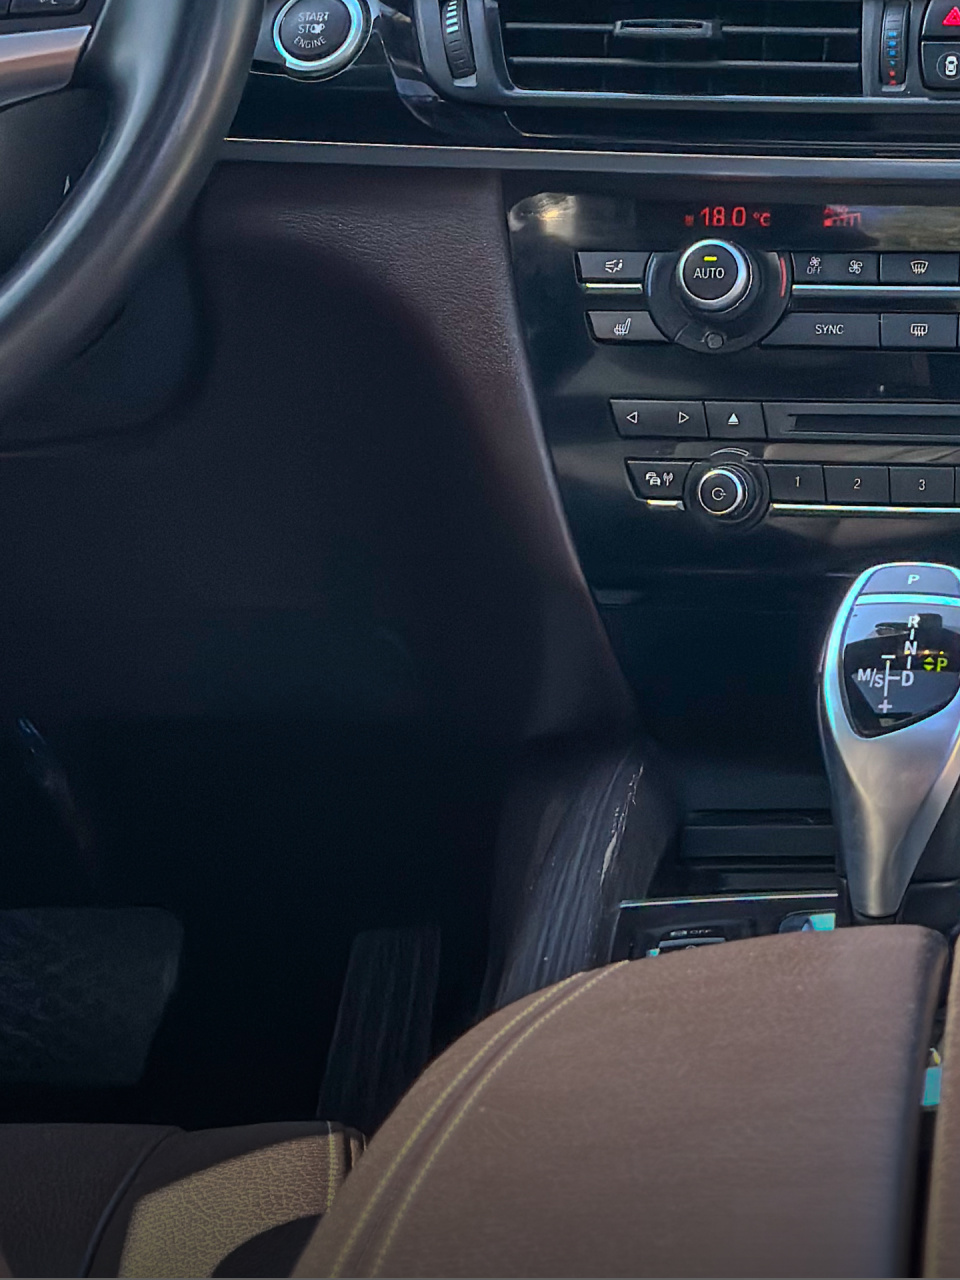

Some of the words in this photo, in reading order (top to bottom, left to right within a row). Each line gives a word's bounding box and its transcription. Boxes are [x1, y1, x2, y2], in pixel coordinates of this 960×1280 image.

[298, 11, 330, 22] START
[298, 23, 326, 34] STOP
[294, 35, 327, 49] ENGINE
[694, 267, 725, 279] AUTO
[807, 266, 822, 274] OFF
[815, 323, 844, 335] SYNC
[794, 476, 800, 487] 1
[853, 478, 861, 490] 2
[918, 479, 926, 491] 3
[907, 574, 920, 585] P
[907, 615, 920, 628] R
[904, 640, 918, 655] N
[936, 657, 948, 672] P
[857, 668, 884, 687] M/S
[901, 671, 915, 687] D
